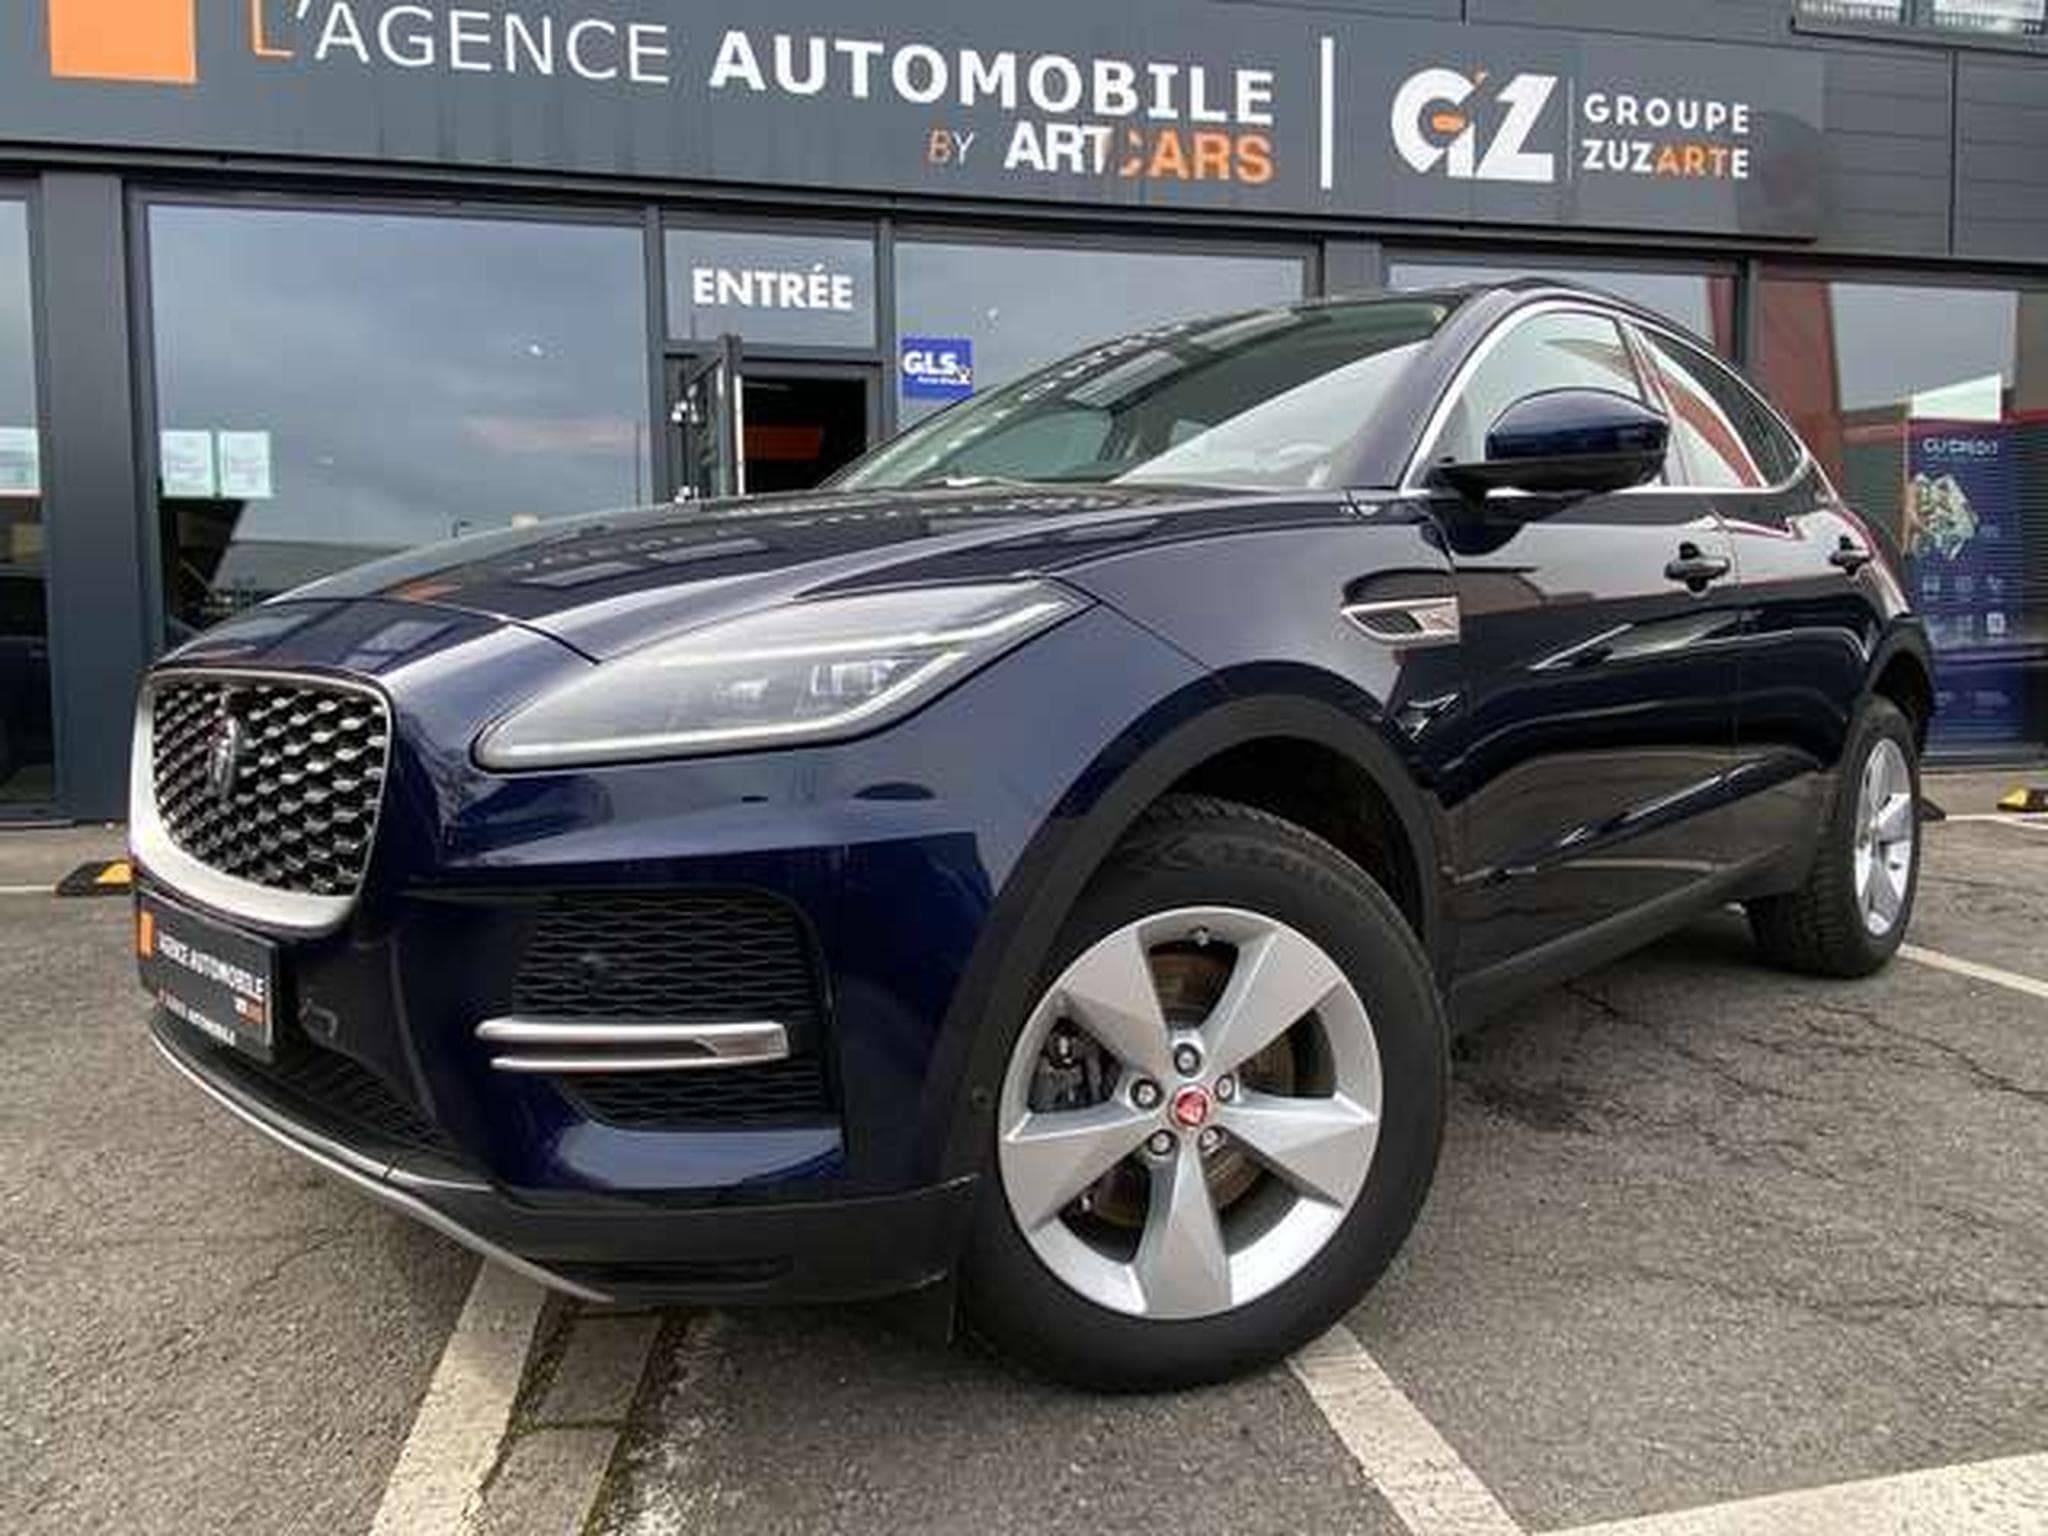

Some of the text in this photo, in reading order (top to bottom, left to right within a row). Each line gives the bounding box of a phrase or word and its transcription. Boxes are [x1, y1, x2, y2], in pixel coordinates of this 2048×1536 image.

[252, 0, 1275, 124] L'AGENCE AUTOMOBILE
[1583, 93, 1750, 133] GROUPE
[928, 128, 975, 165] BY
[1581, 139, 1750, 179] ZUZARTE
[692, 262, 854, 311] ENTRÉE
[903, 351, 957, 376] GLS
